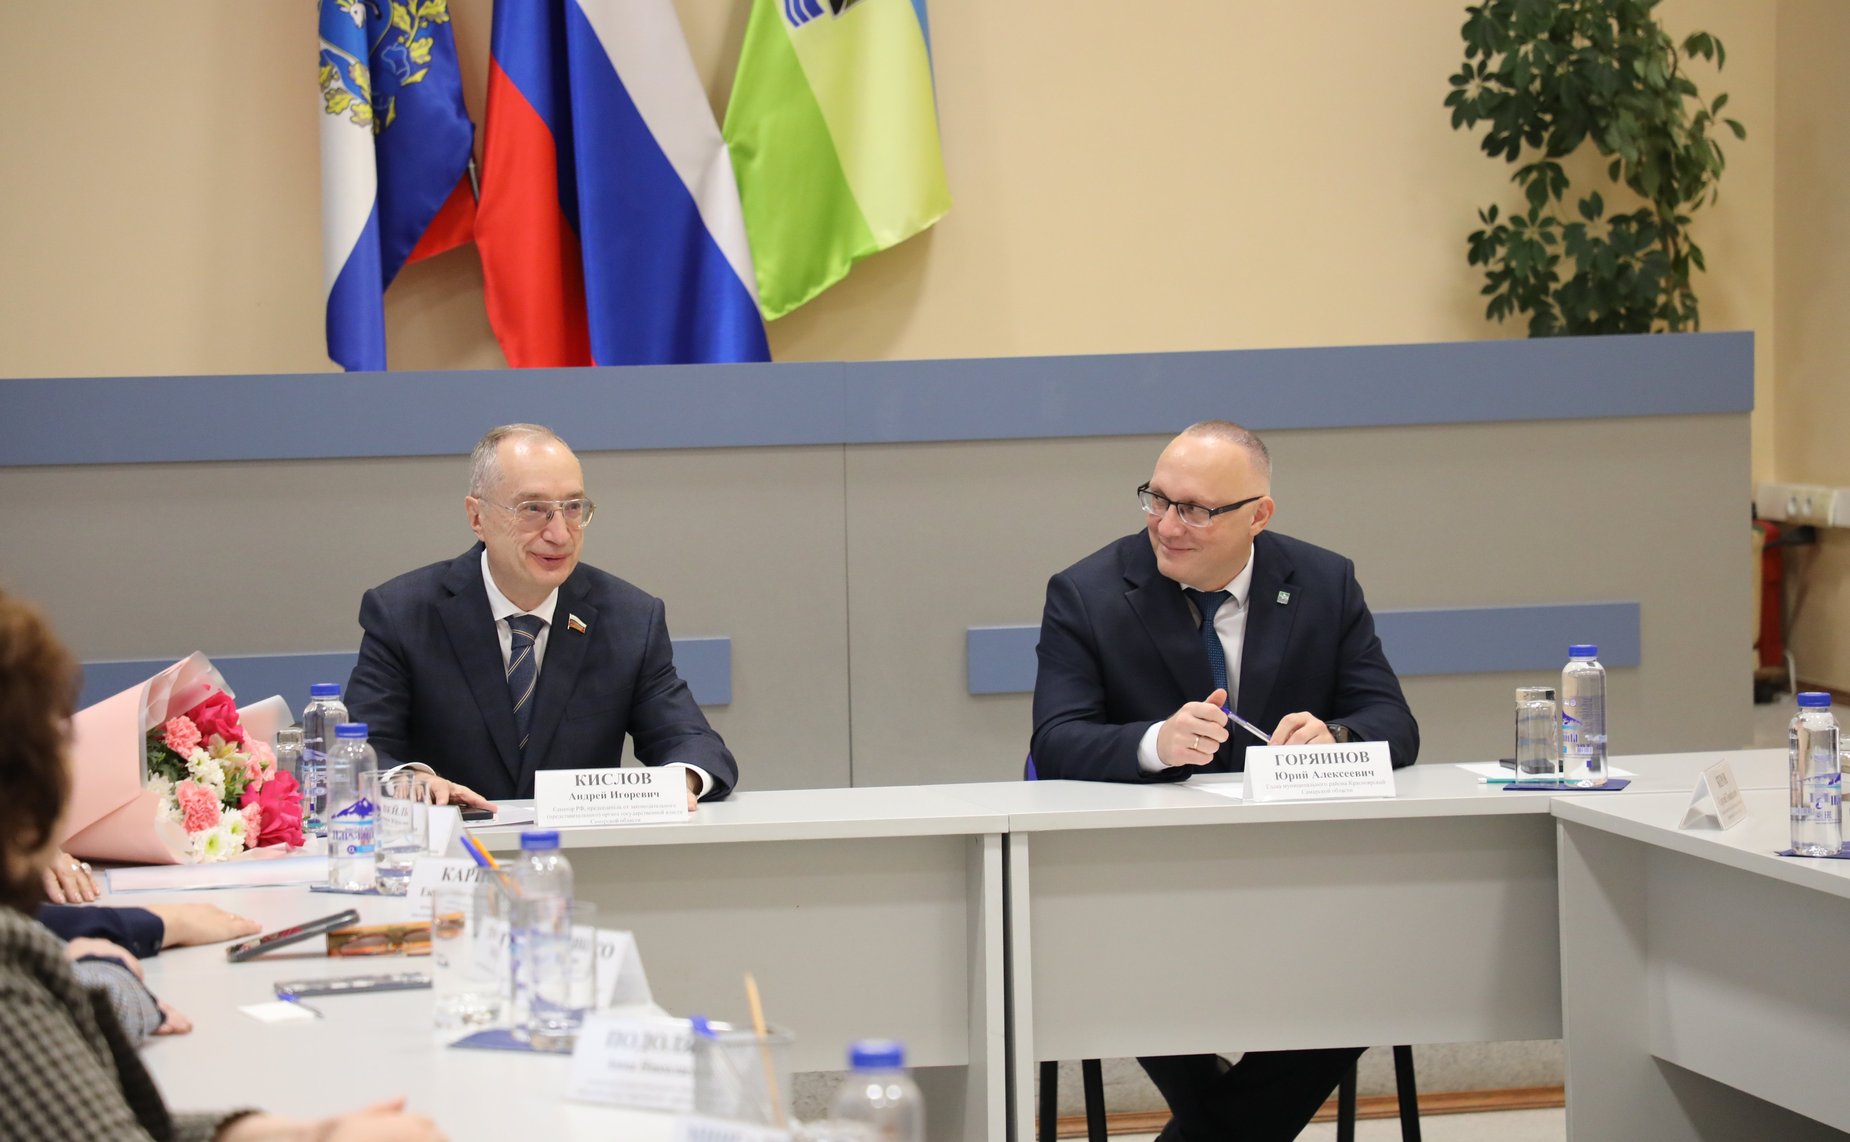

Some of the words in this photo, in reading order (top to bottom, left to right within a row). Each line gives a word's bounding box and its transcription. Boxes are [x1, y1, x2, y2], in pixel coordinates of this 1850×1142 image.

[1275, 751, 1370, 766] ГОРЯИНОВ
[575, 772, 651, 786] КИСЛОВ
[1275, 771, 1309, 783] Юрий
[1312, 770, 1375, 780] Алексеевич
[569, 790, 606, 802] Андрей
[611, 789, 660, 800] Игоревич
